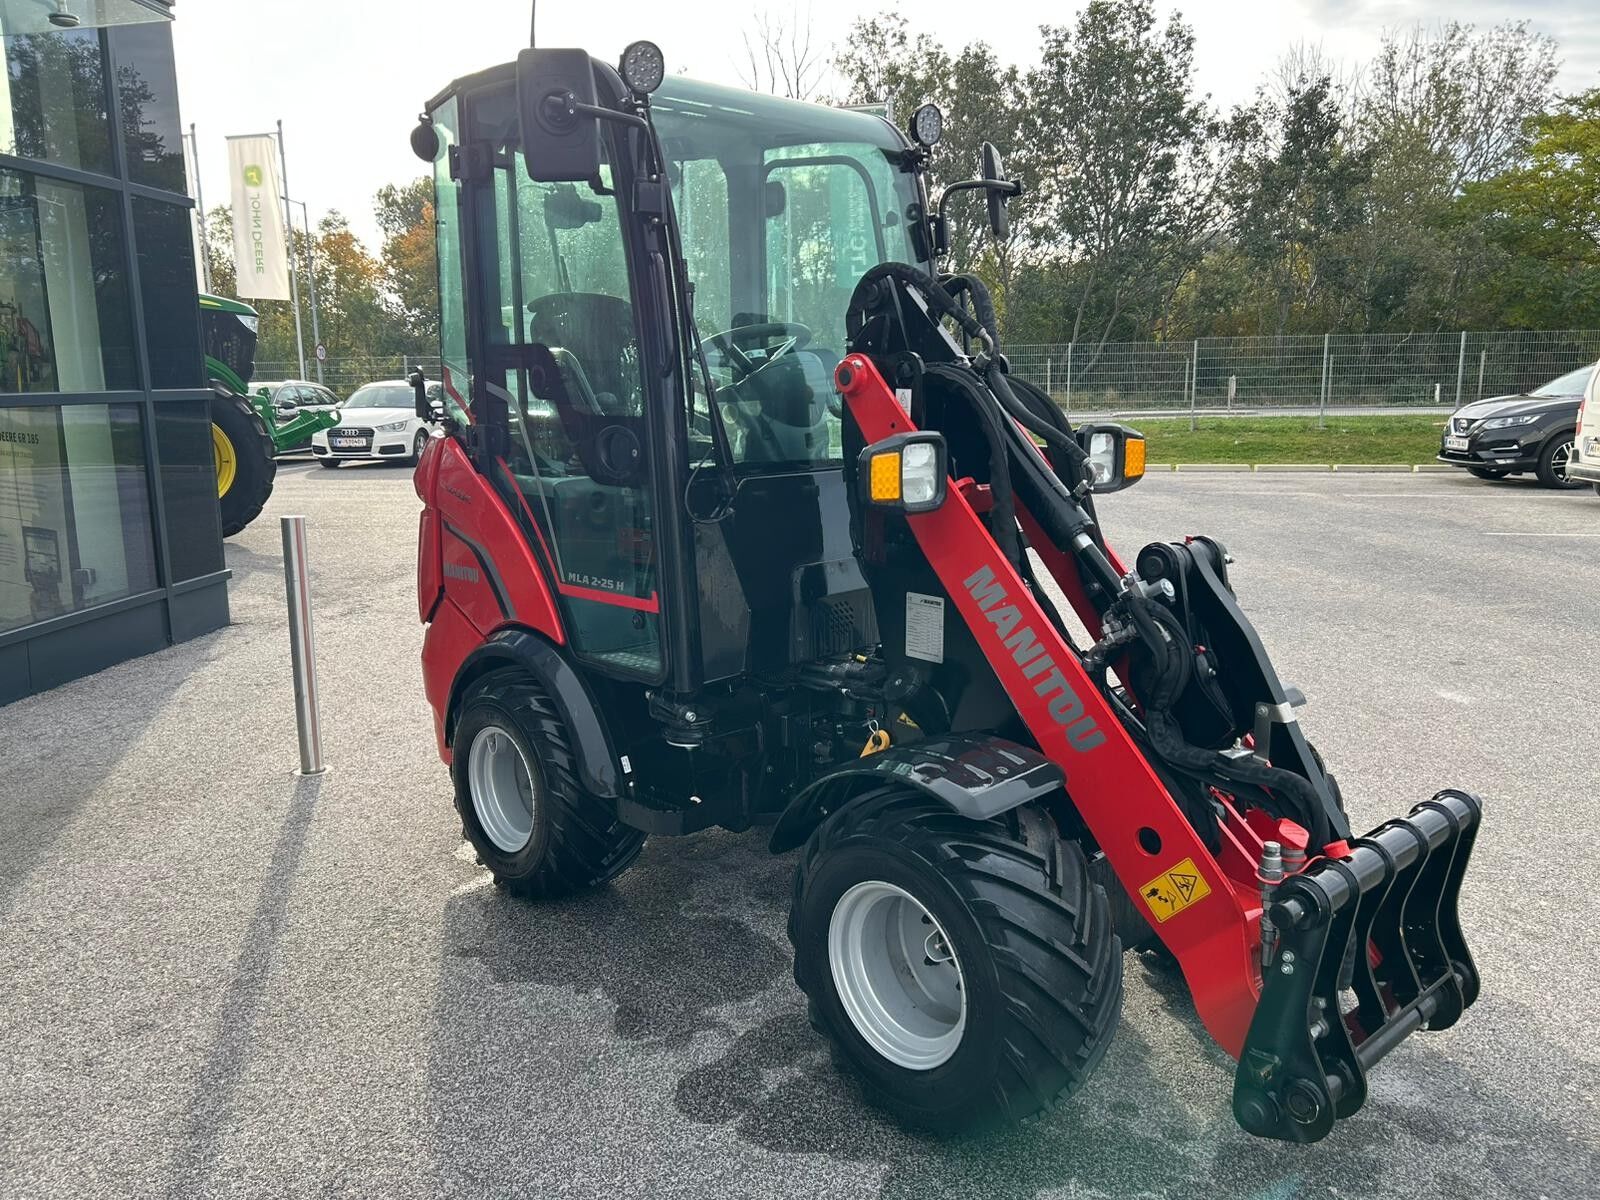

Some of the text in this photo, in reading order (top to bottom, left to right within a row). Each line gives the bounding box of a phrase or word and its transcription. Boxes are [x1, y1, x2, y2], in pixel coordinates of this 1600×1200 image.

[568, 572, 625, 592] MLA 2-25 H
[963, 564, 1108, 753] MANITOU
